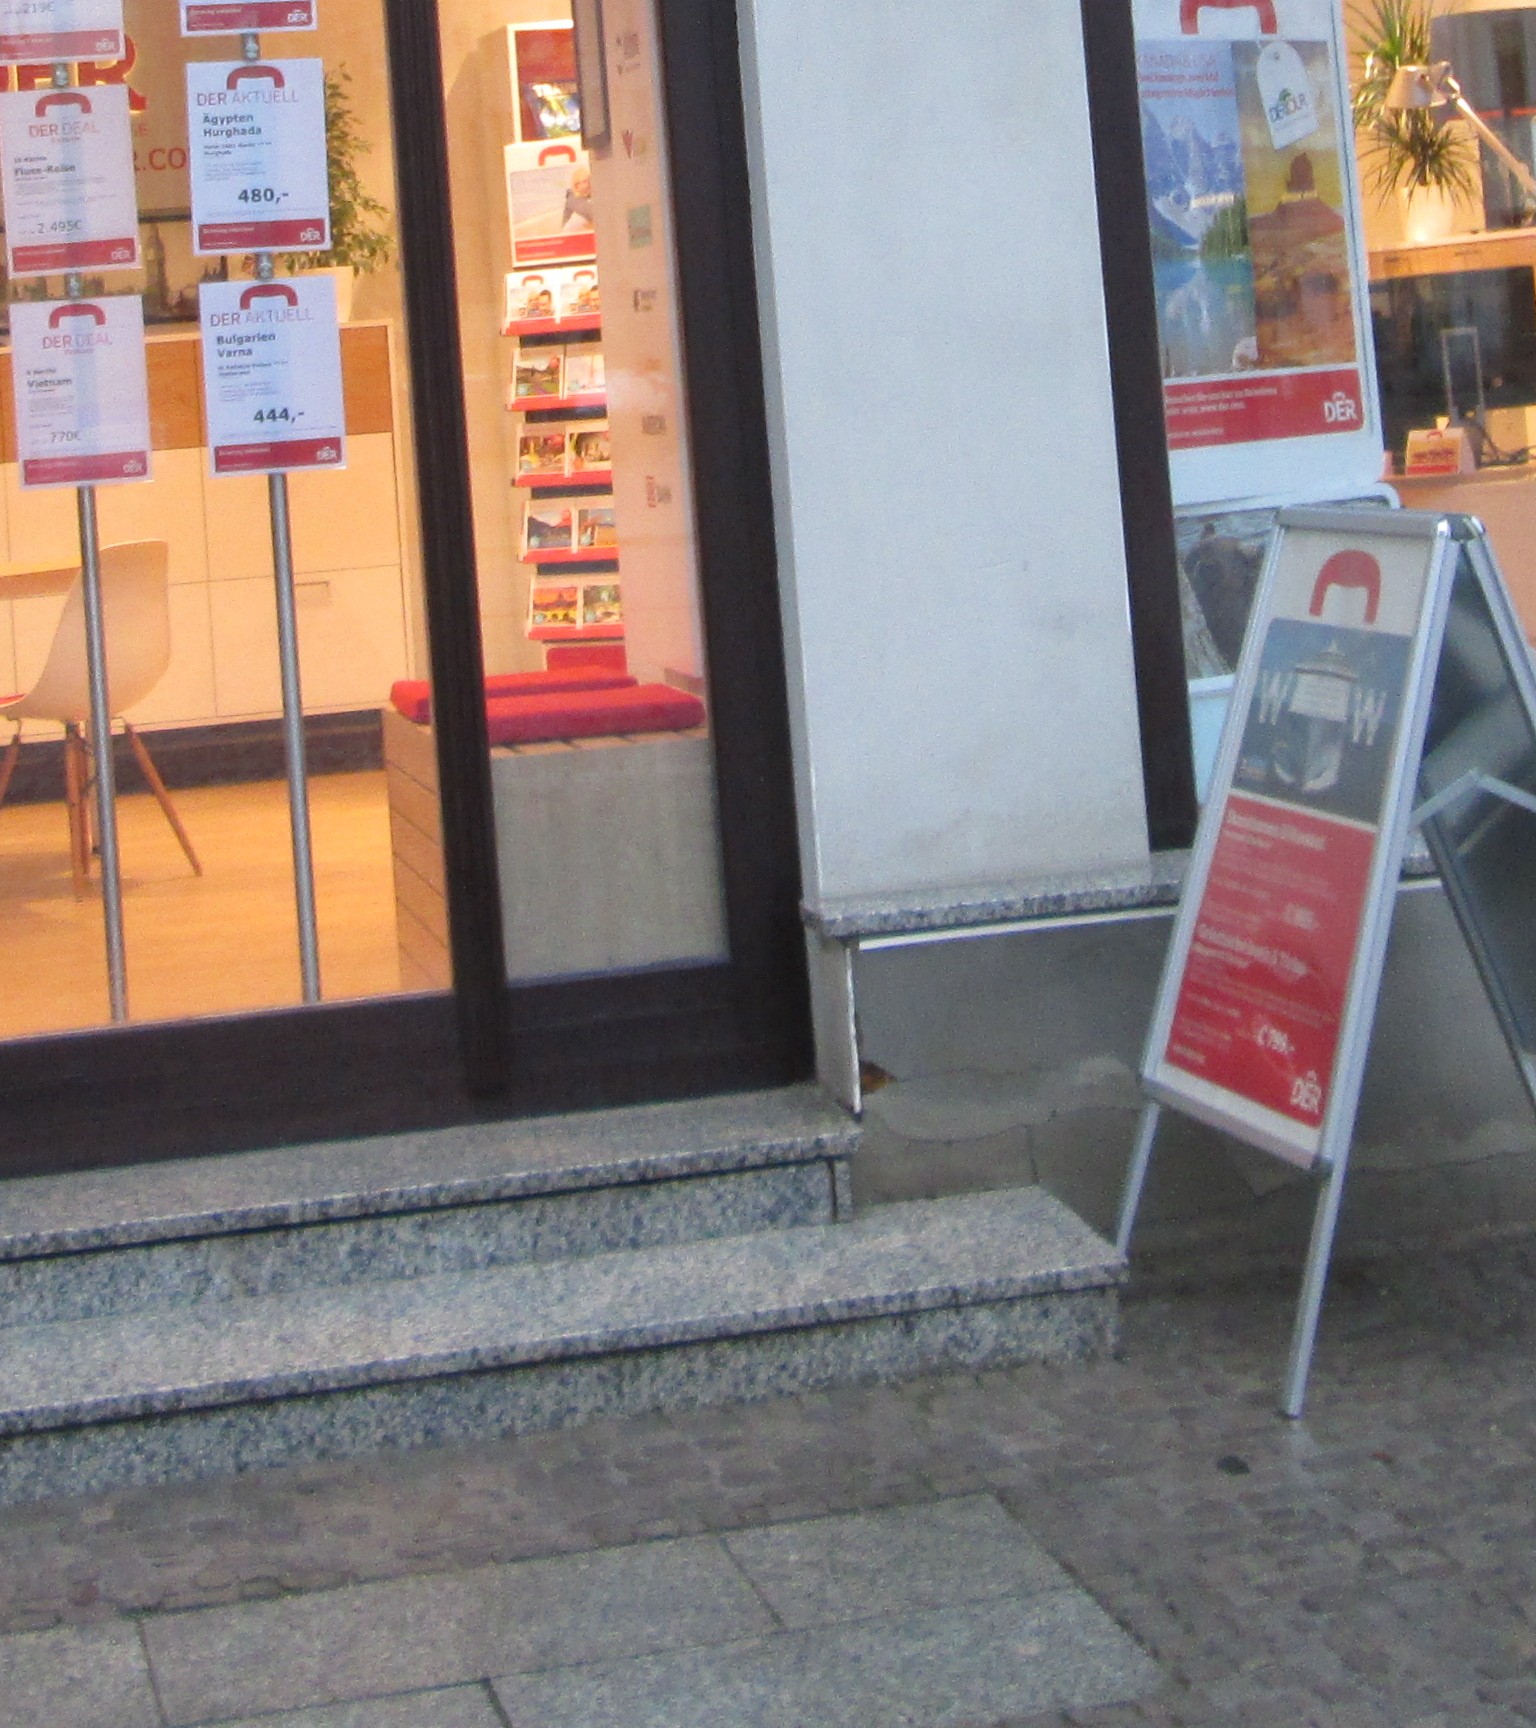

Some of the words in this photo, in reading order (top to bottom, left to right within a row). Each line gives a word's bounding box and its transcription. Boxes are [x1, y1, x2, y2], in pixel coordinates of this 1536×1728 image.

[196, 92, 228, 107] DER
[231, 89, 299, 105] AKTUELL
[202, 111, 254, 125] Ägypten
[28, 123, 59, 138] DER
[202, 126, 262, 138] Hurghada
[237, 187, 290, 204] 480,-
[209, 313, 241, 328] DER
[245, 306, 315, 324] AKTUELL
[41, 335, 73, 350] DER
[216, 332, 277, 346] Bulgarien
[217, 347, 253, 359] Varna
[253, 407, 306, 424] 444,-
[1323, 399, 1359, 423] DER
